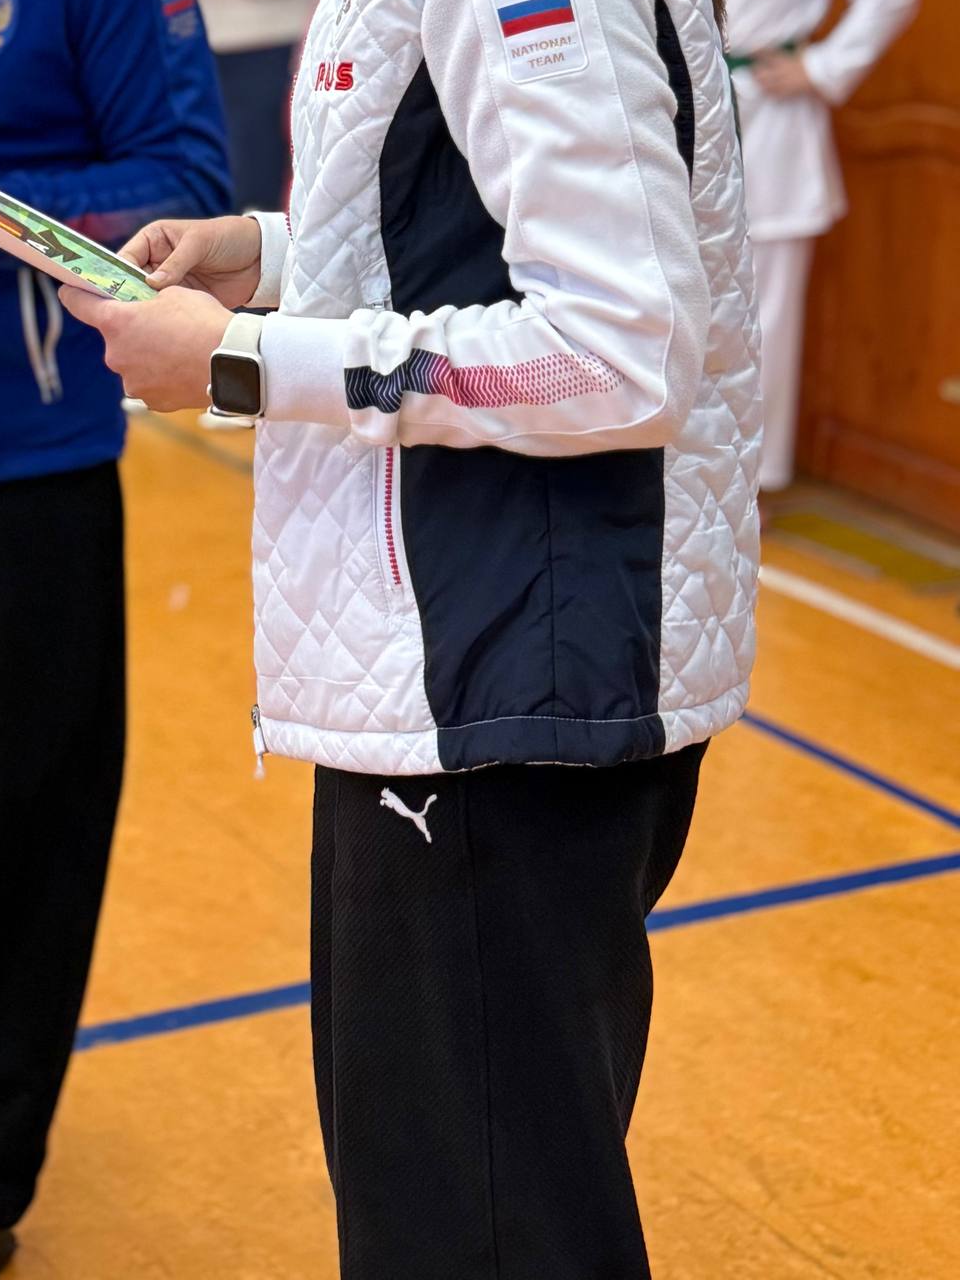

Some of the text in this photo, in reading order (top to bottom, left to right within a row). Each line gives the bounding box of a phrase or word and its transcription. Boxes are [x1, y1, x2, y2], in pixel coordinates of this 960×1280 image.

[511, 34, 576, 59] NATIONAL
[528, 52, 565, 69] TEAM
[314, 61, 354, 91] RUS
